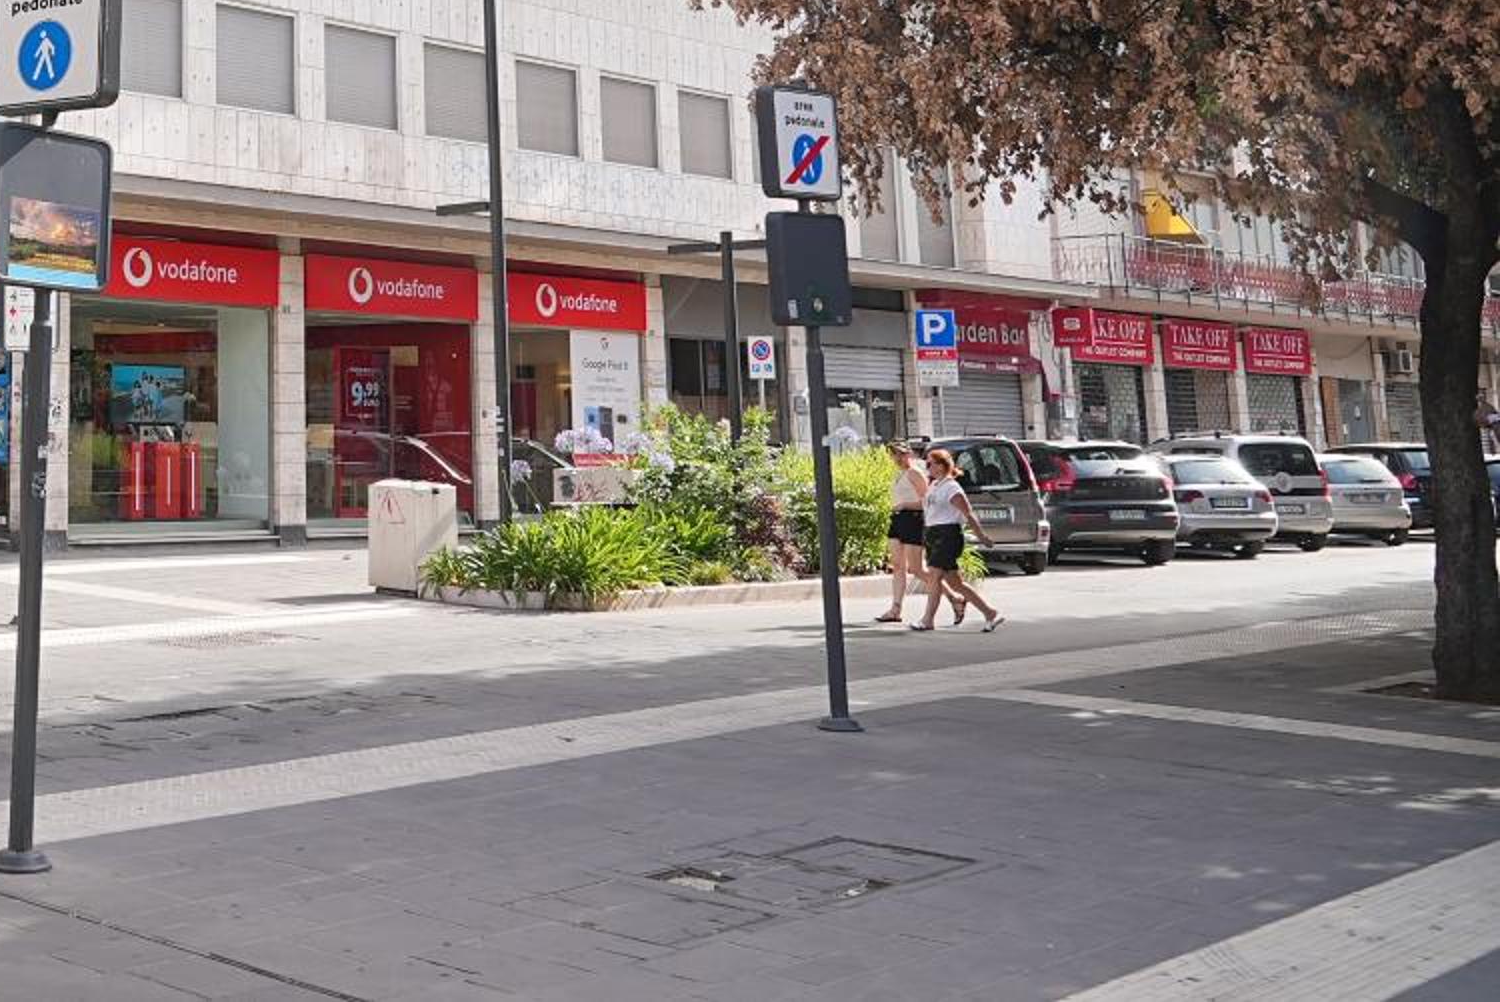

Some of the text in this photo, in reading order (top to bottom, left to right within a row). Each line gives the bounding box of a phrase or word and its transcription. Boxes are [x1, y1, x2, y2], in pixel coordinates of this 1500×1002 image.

[157, 258, 238, 283] vodafone
[377, 277, 444, 299] vodafone
[560, 293, 617, 313] vodafone
[921, 313, 947, 344] P
[1119, 319, 1146, 341] OFF
[1170, 325, 1229, 349] TAKE OFF
[1251, 333, 1303, 355] TAKE OFF
[582, 358, 606, 372] Google
